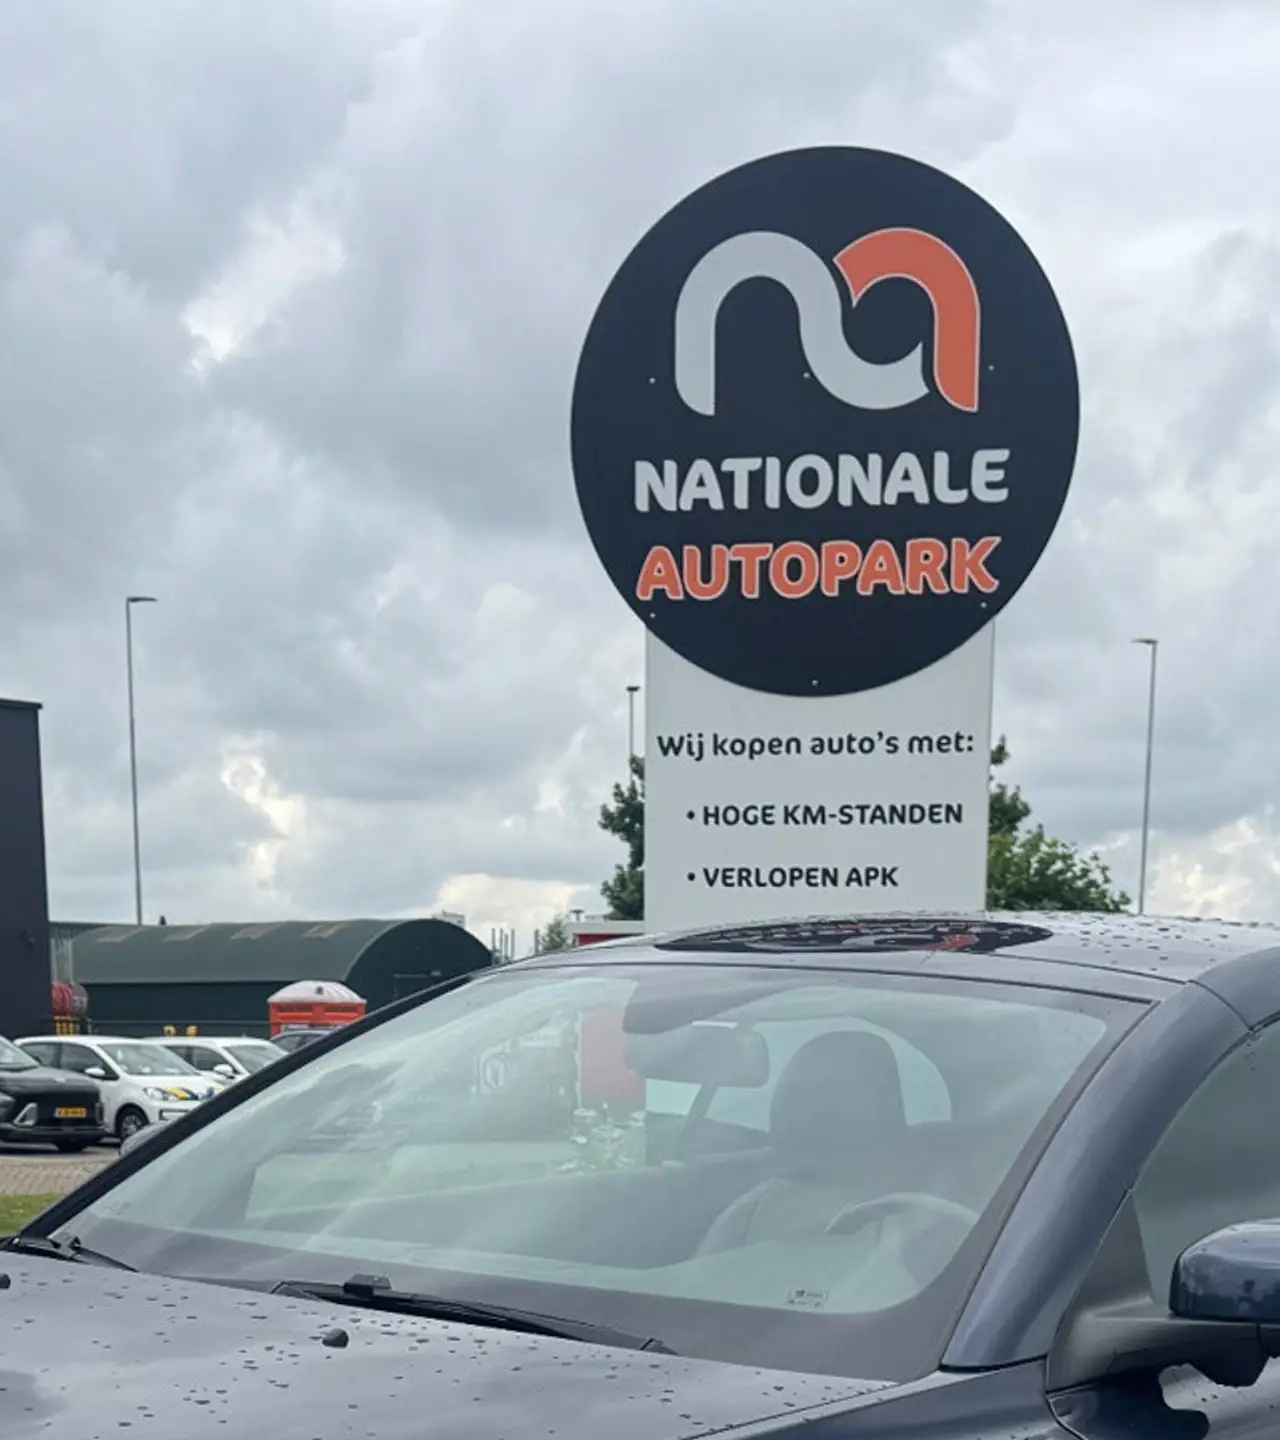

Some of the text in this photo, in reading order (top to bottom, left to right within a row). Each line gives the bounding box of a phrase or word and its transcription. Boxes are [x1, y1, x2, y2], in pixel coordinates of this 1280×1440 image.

[634, 448, 1010, 513] NATIONALE
[635, 536, 1002, 601] AUTOPARK
[657, 731, 974, 762] Wij kopen auto's met:
[702, 803, 964, 827] HOGE KM-STANDEN
[702, 866, 899, 889] VERLOPEN APK
